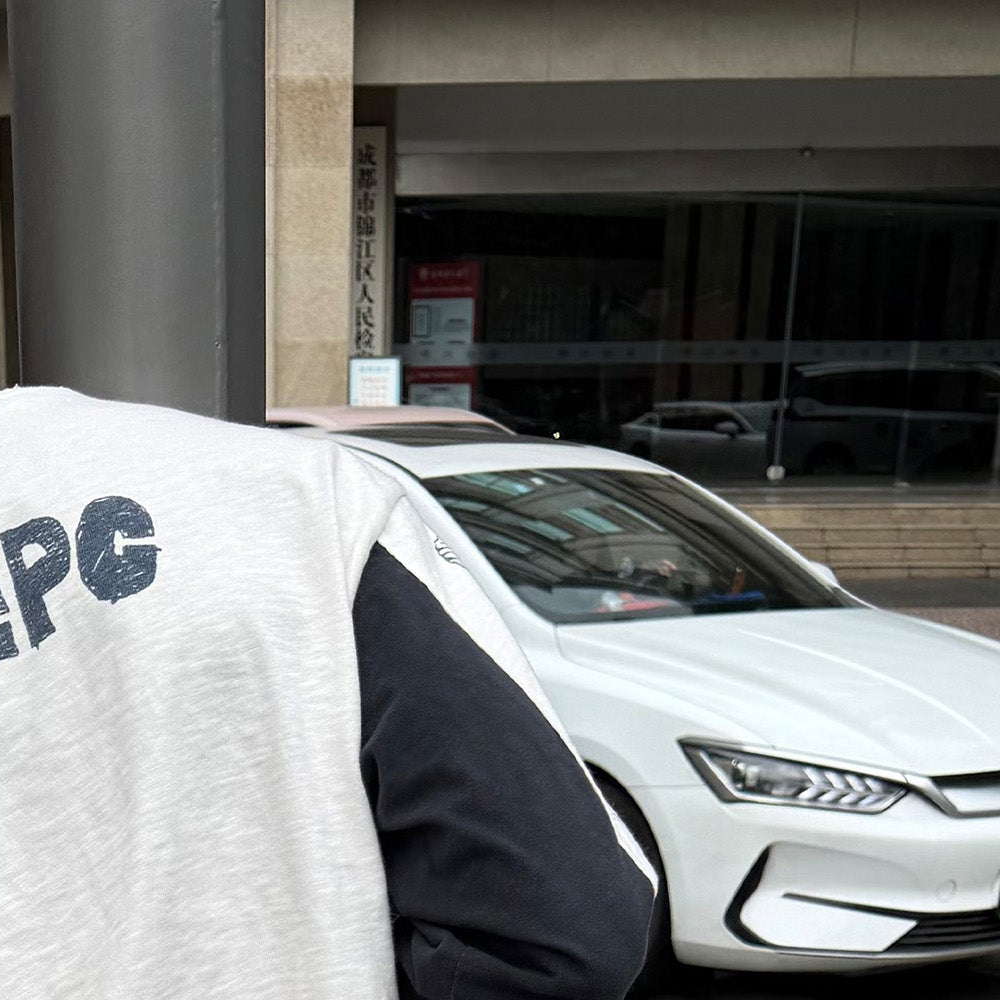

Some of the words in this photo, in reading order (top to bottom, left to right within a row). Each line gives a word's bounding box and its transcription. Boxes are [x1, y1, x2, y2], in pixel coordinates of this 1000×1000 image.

[355, 143, 378, 356] 成都市锦江区人民检
